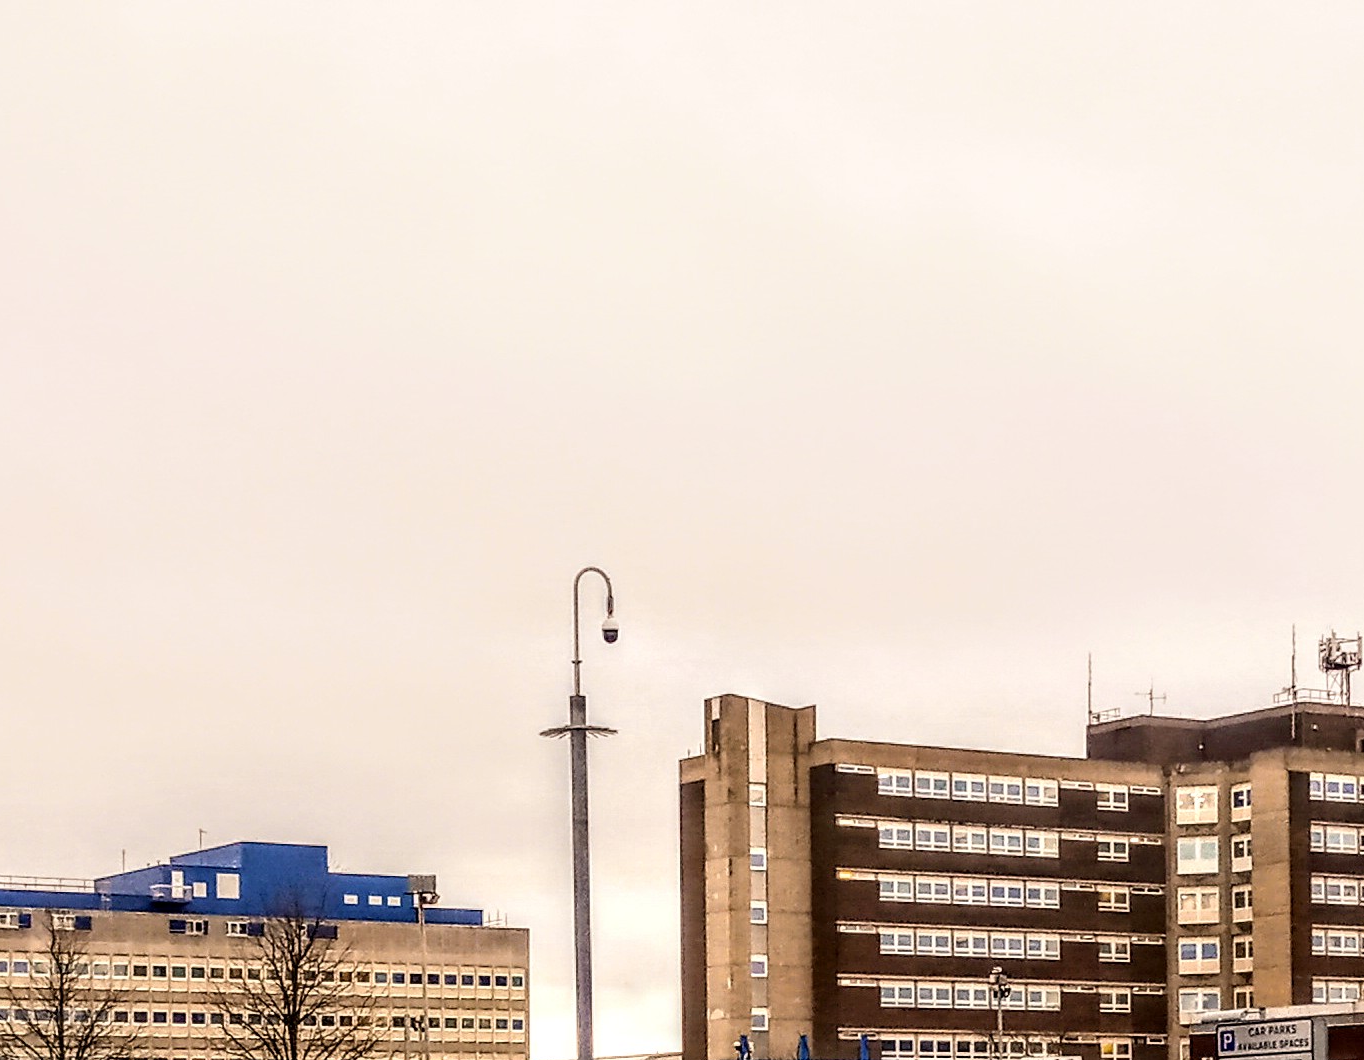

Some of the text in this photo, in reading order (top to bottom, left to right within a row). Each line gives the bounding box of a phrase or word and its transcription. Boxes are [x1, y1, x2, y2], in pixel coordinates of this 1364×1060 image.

[1248, 1024, 1297, 1038] CAR PARKS
[1237, 1038, 1309, 1051] AVAILABLE SPACES
